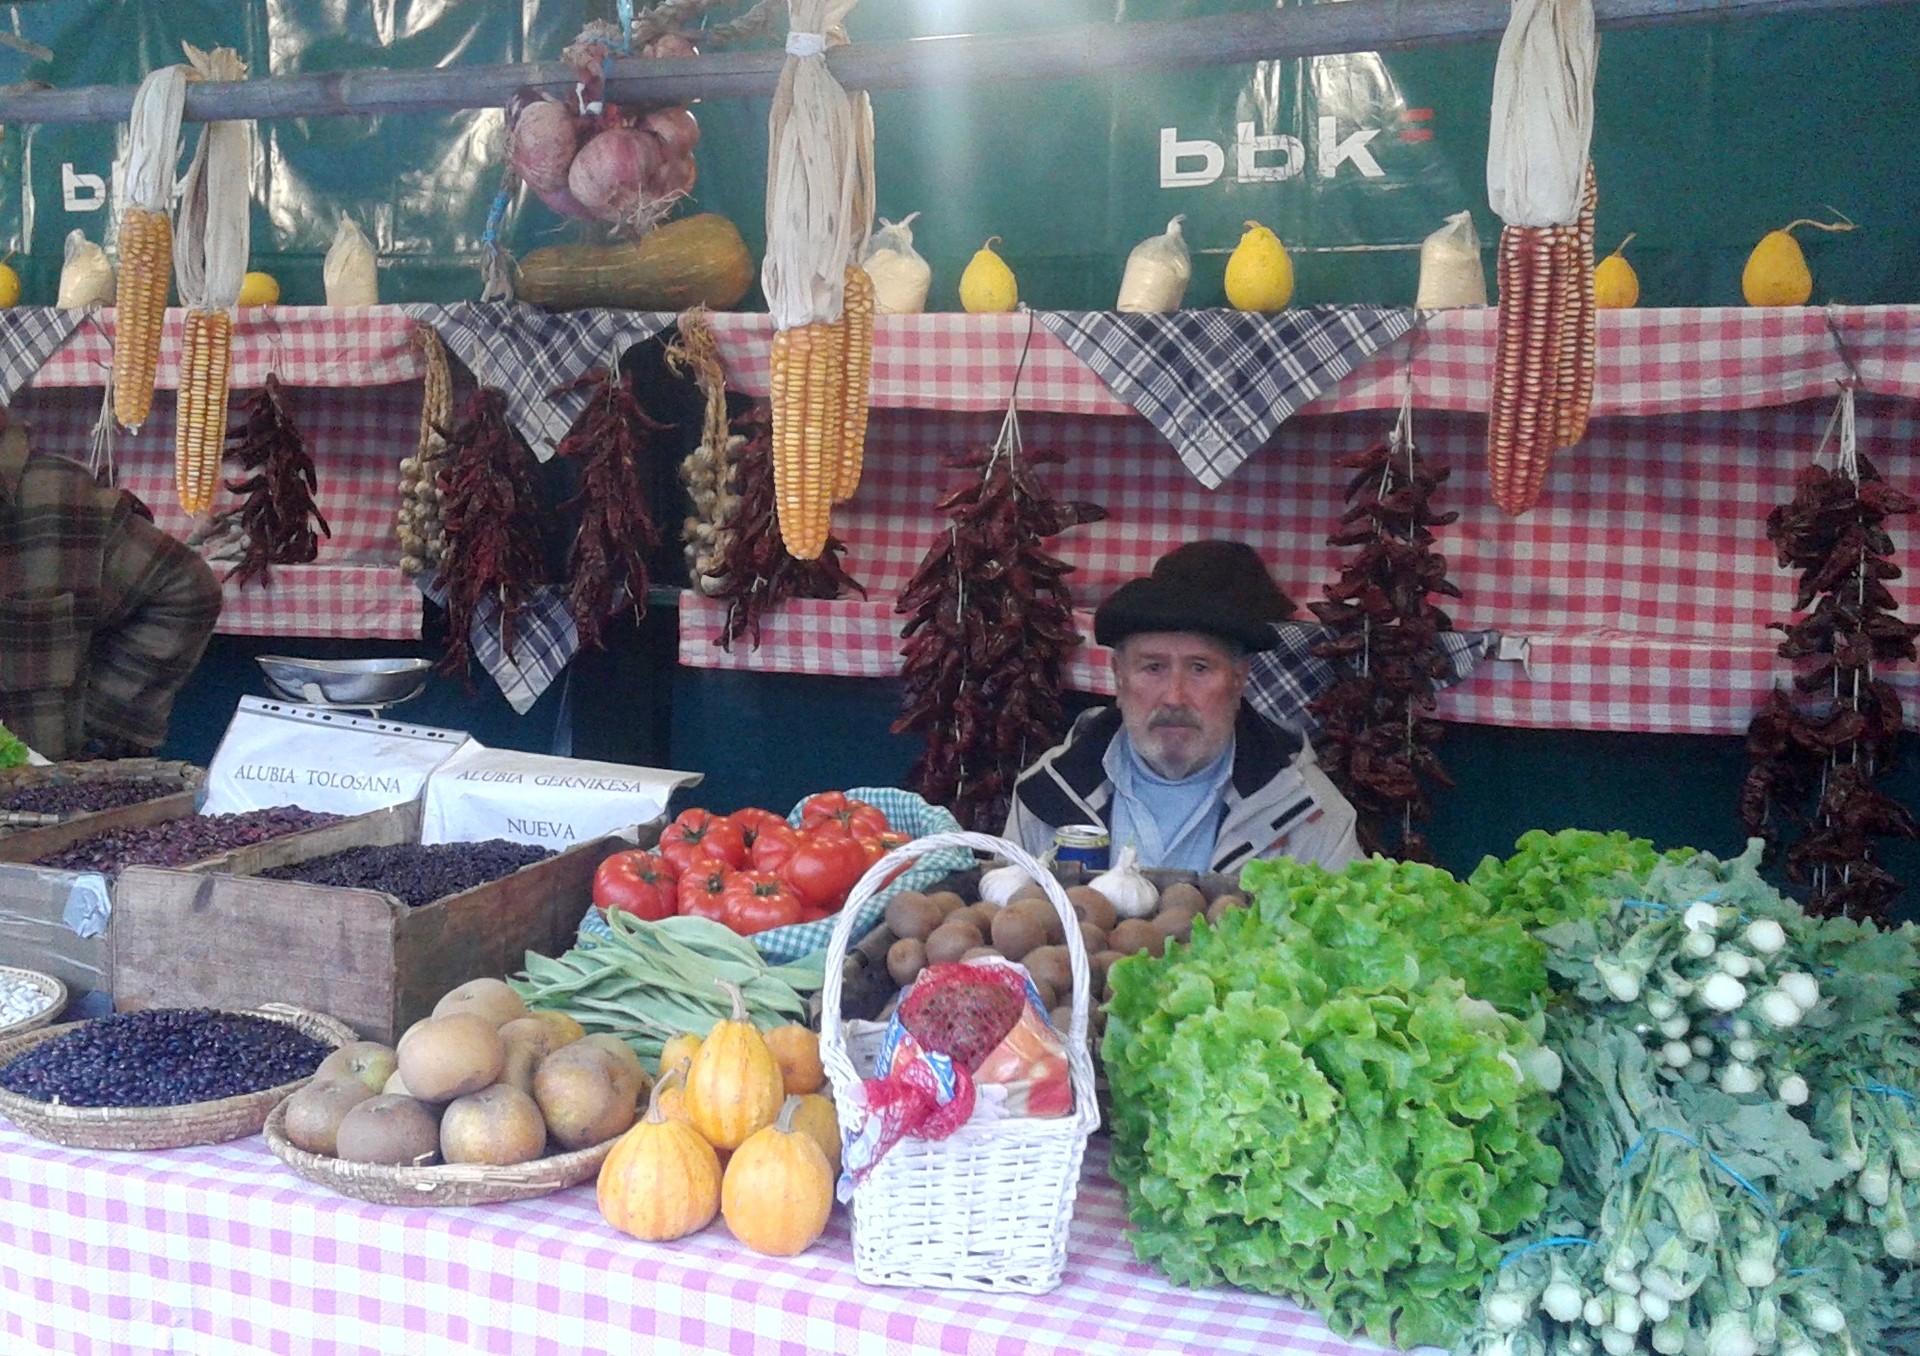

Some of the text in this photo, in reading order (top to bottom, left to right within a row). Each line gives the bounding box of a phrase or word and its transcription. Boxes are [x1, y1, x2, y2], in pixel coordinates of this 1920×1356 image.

[1160, 116, 1386, 188] bbk
[234, 765, 401, 794] ALUBIA TOLOSANA
[455, 770, 642, 793] ALUBIA GERNIKESA
[507, 818, 576, 840] NUEVA
